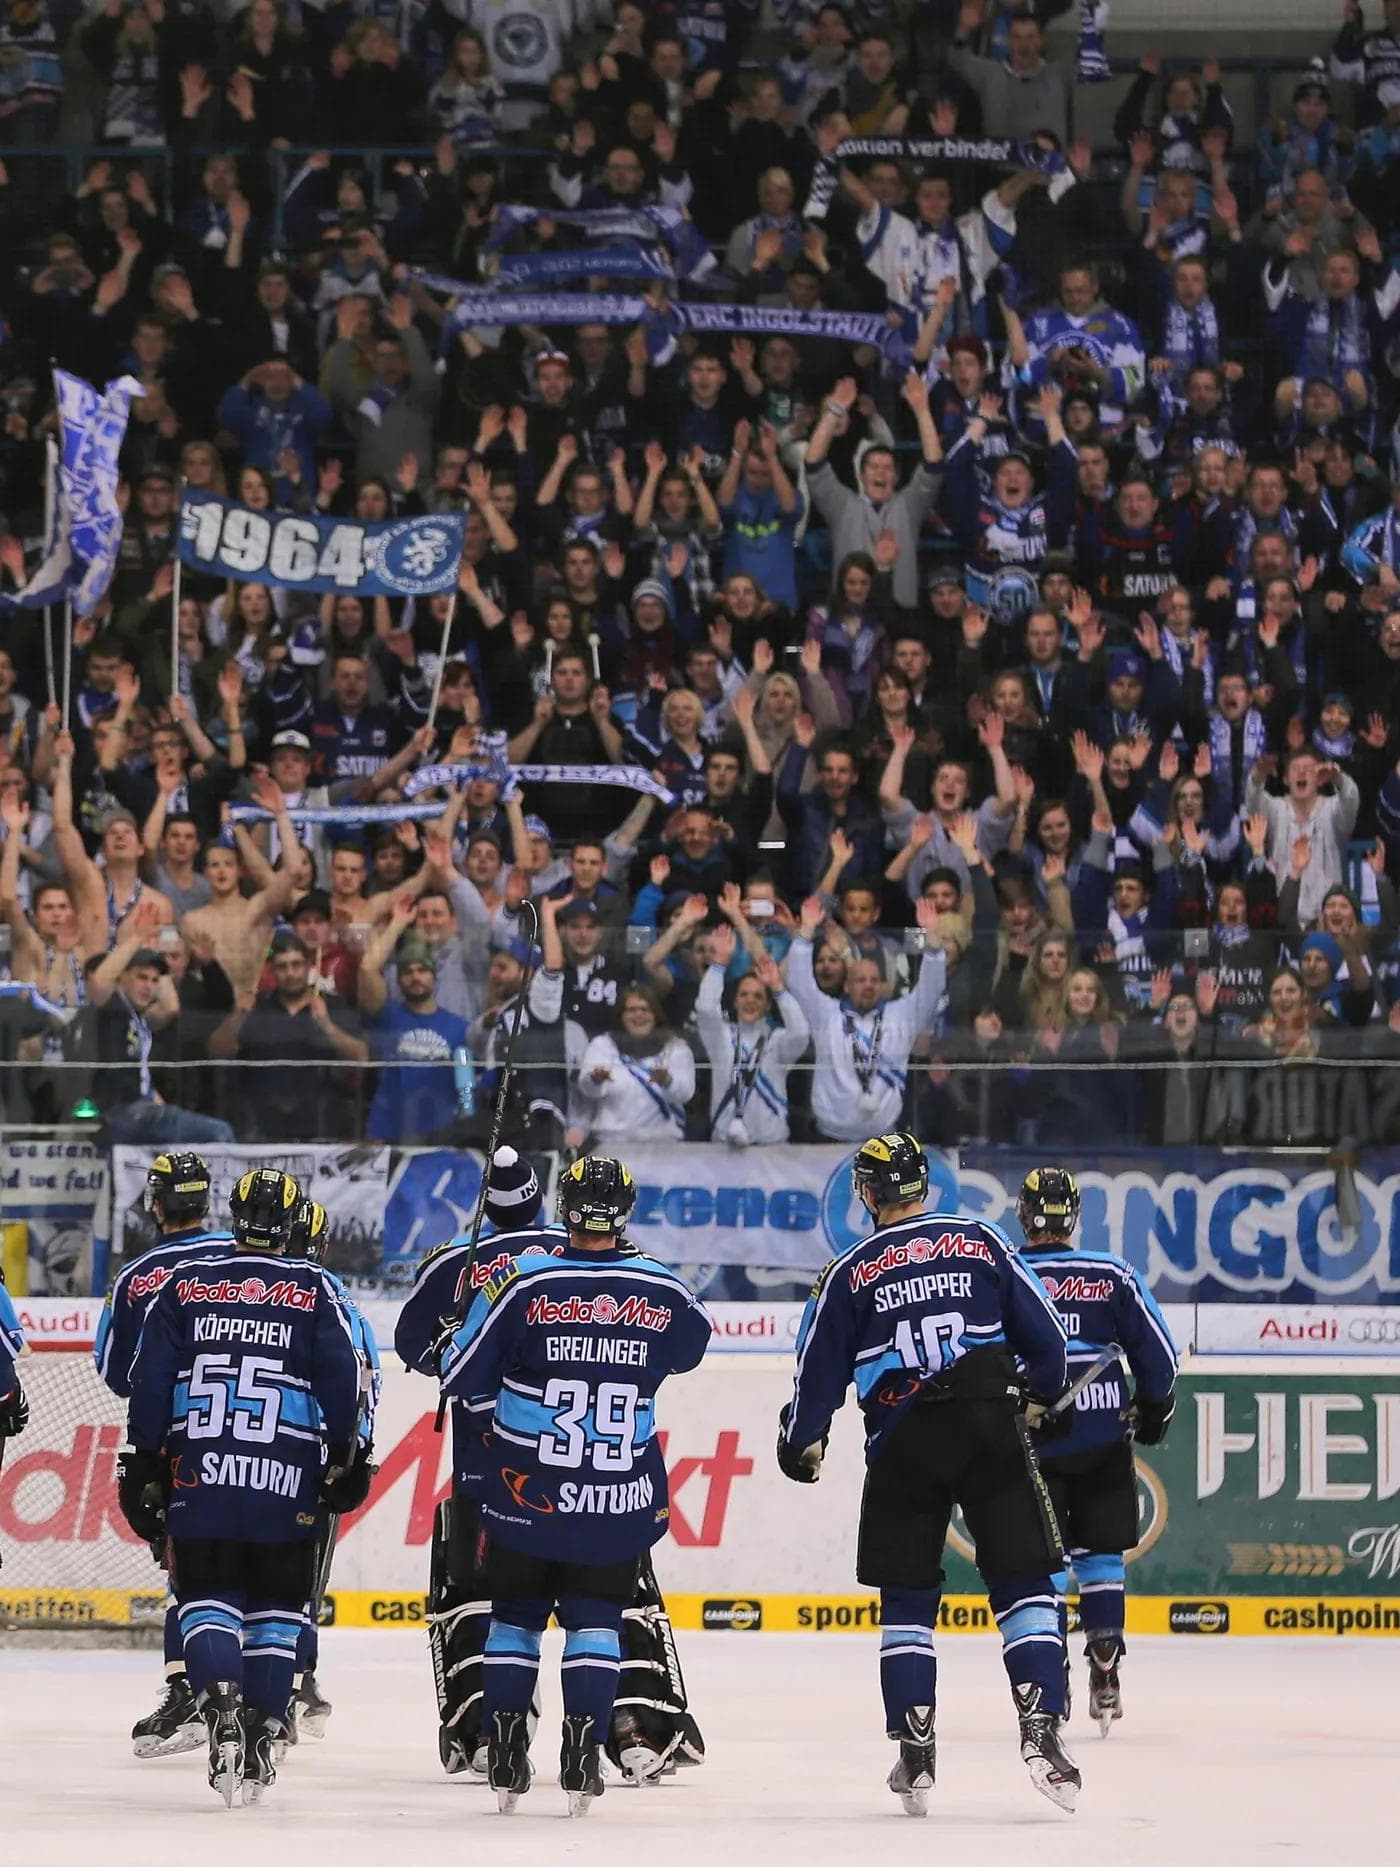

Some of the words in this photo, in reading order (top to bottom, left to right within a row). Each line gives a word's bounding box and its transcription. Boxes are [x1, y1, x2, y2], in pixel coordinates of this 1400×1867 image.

[191, 502, 366, 586] 1964
[889, 1172, 900, 1182] 10
[581, 1204, 592, 1214] 39
[607, 1206, 618, 1215] 39
[270, 1224, 281, 1234] 55
[874, 1272, 973, 1313] SCHOPPER
[1055, 1276, 1114, 1302] Markt
[19, 1310, 90, 1332] Audi
[525, 1295, 593, 1325] Media
[194, 1313, 293, 1350] KÖPPCHEN
[1259, 1317, 1338, 1341] Audi
[546, 1335, 648, 1368] GREILINGER
[187, 1353, 284, 1444] 55
[538, 1378, 639, 1472] 39
[201, 1452, 303, 1499] SATURN
[558, 1473, 654, 1515] SATURN
